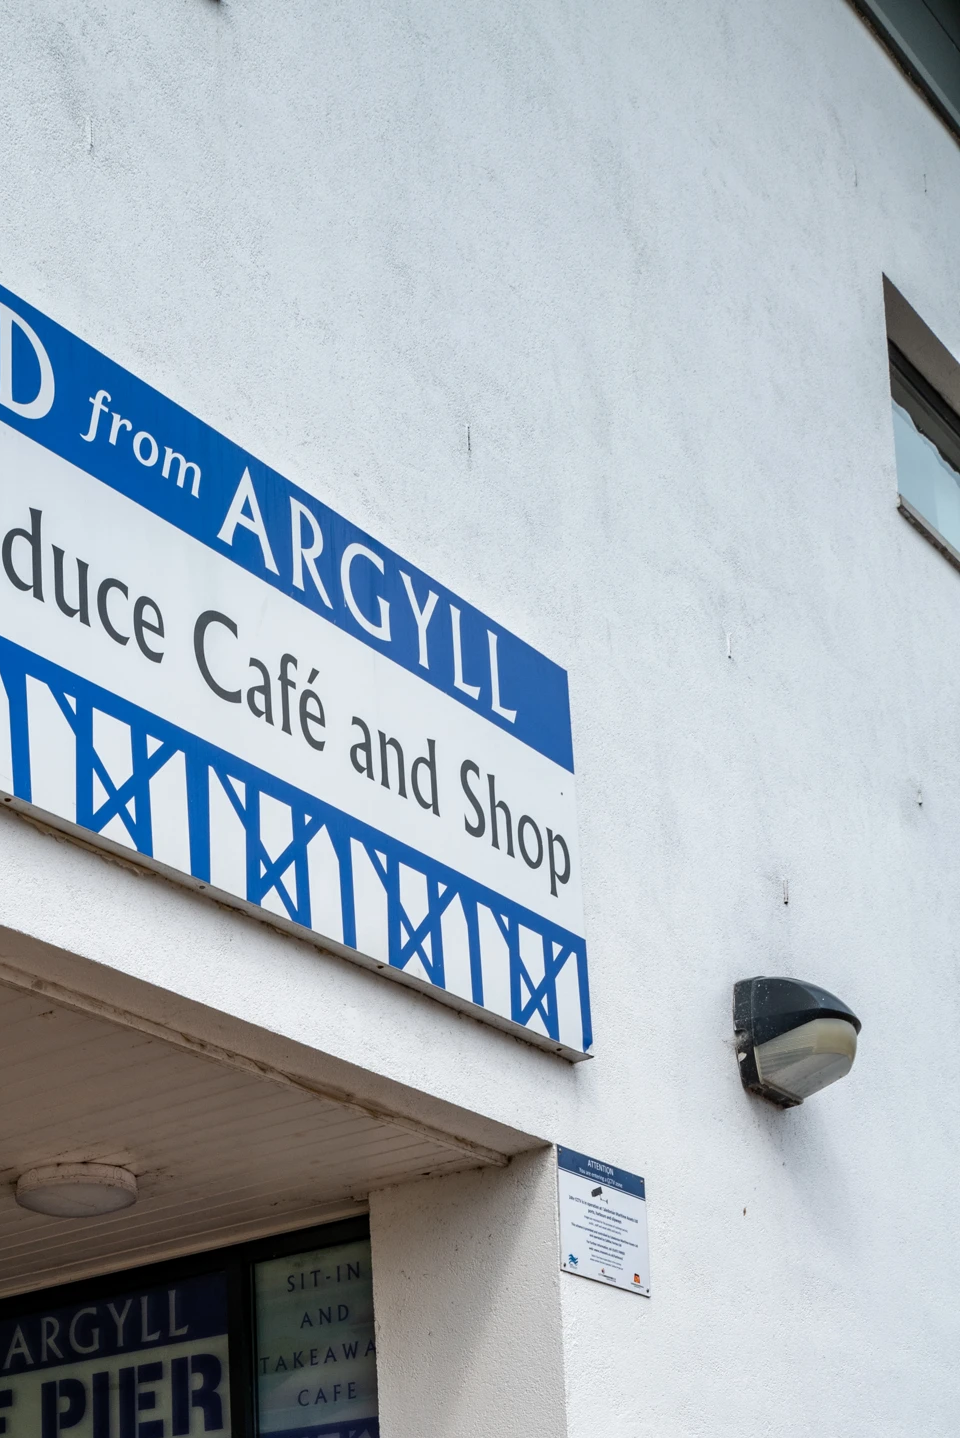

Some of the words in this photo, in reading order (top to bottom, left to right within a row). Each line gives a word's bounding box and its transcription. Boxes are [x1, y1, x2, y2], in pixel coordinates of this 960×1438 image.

[80, 389, 202, 499] from
[217, 466, 516, 723] ARGYLL
[193, 610, 326, 752] Café
[349, 715, 441, 818] and
[459, 759, 571, 897] Shop
[588, 1160, 614, 1176] ATTENTION
[287, 1261, 360, 1292] SIT-IN
[2, 1289, 190, 1371] ARGYLL
[300, 1304, 349, 1328] AND
[259, 1339, 376, 1374] TAKEAWA
[297, 1382, 357, 1407] CAFE
